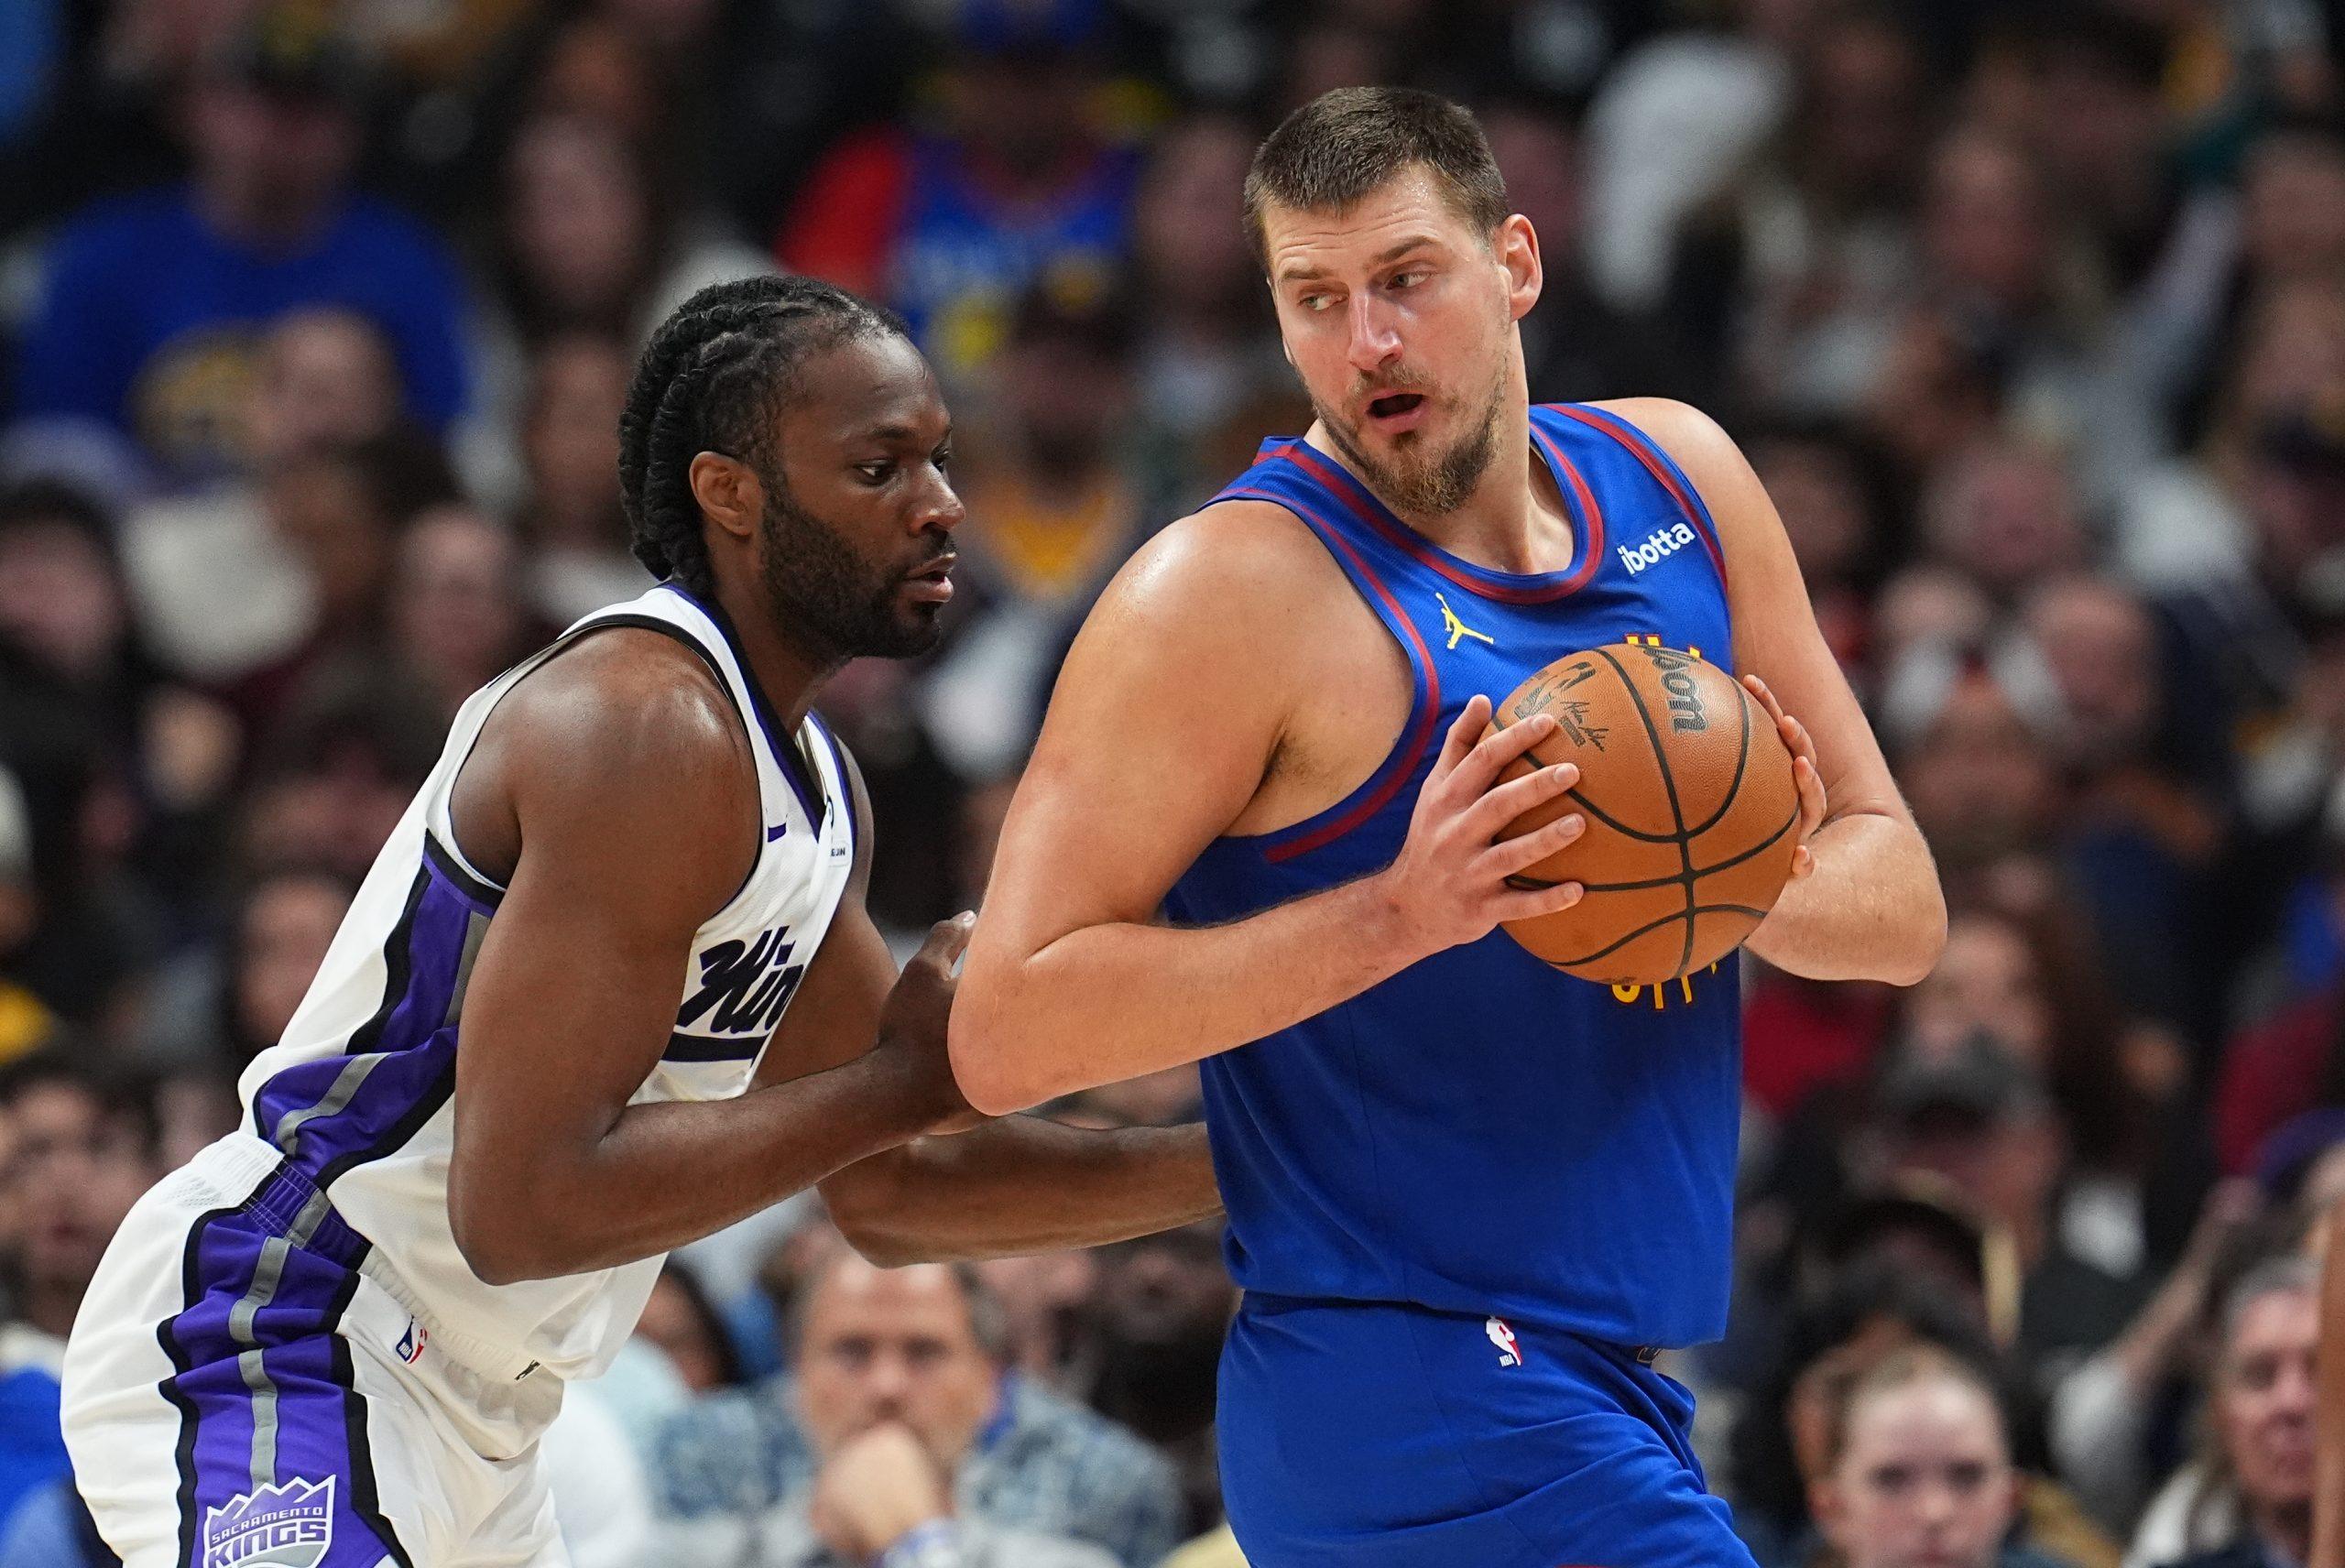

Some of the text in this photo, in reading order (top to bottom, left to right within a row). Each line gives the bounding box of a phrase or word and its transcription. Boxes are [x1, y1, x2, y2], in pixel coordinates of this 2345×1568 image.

[1617, 523, 1696, 575] ibotta
[675, 925, 804, 1034] Kin
[398, 1342, 411, 1358] NBA
[1499, 1354, 1515, 1367] NBA
[207, 1520, 327, 1568] KINGS
[212, 1507, 323, 1544] SACRAMENTO
